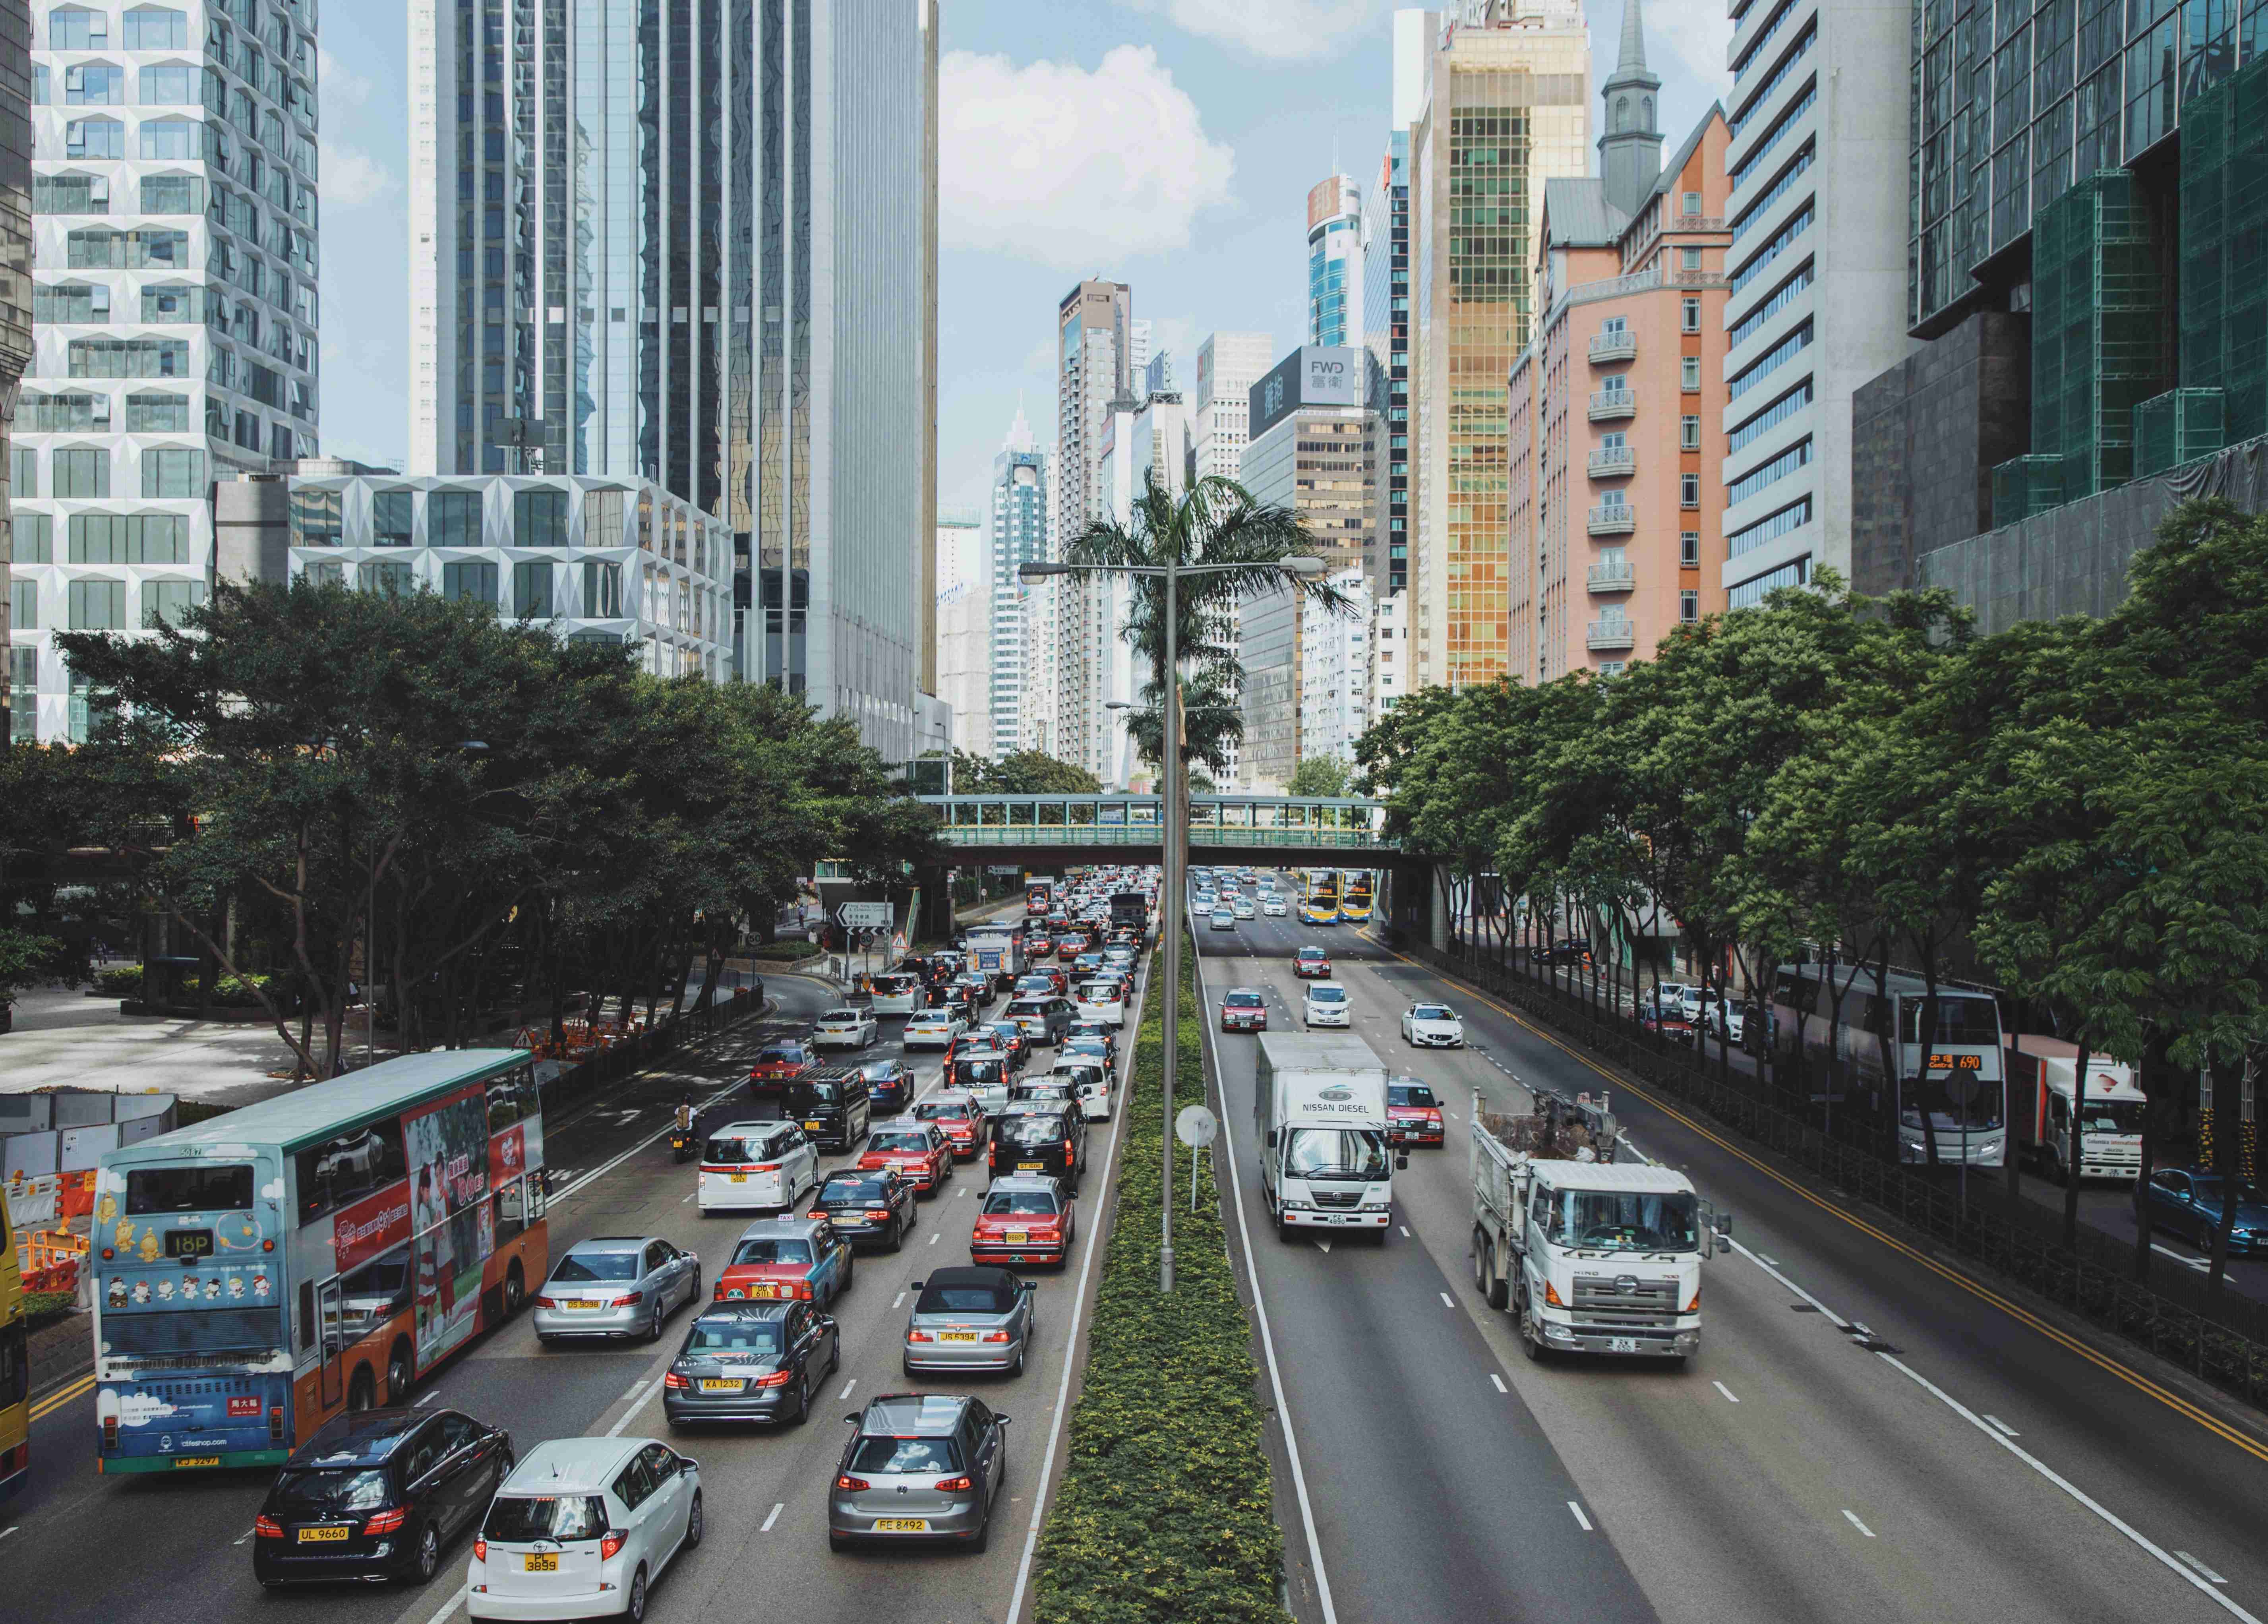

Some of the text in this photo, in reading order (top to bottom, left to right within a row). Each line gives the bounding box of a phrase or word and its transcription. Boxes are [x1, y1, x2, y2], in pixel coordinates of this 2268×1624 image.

[1311, 361, 1344, 374] FWD
[1312, 375, 1343, 389] 富衛
[1960, 1056, 1980, 1069] 690
[1339, 1105, 1369, 1113] DIESEL
[181, 1148, 201, 1157] 5087
[176, 1236, 208, 1253] 18P
[879, 1521, 922, 1530] FE 8492
[319, 1529, 345, 1539] 9660
[527, 1562, 556, 1571] 3899
